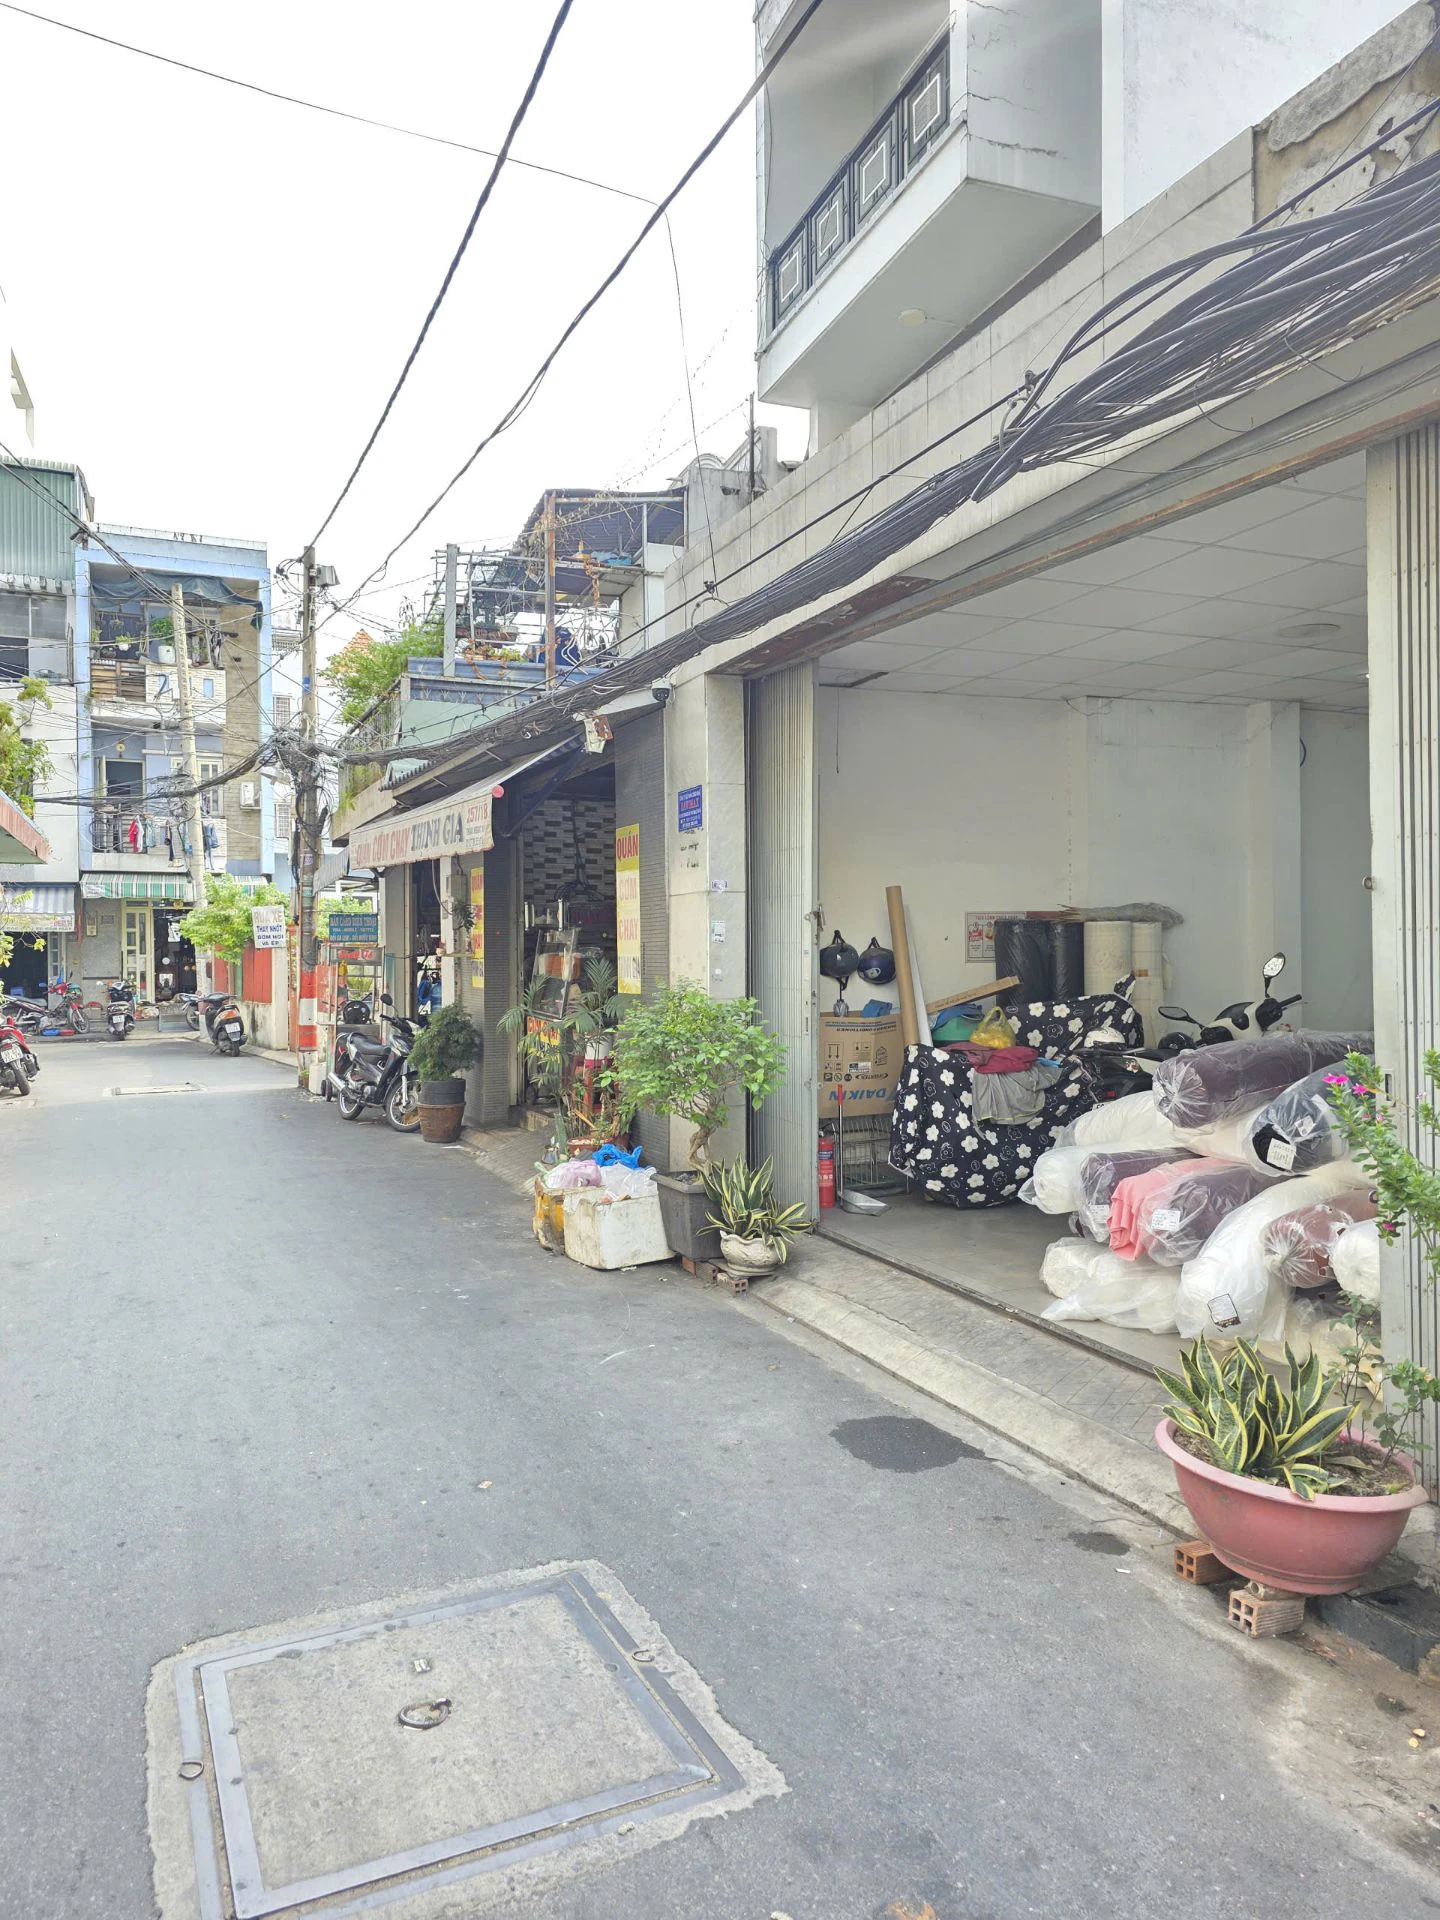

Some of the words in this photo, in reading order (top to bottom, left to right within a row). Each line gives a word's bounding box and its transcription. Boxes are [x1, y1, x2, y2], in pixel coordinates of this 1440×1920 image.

[617, 831, 639, 861] QUÁN
[619, 919, 639, 941] CHAY
[829, 1088, 887, 1101] DAIKIN
